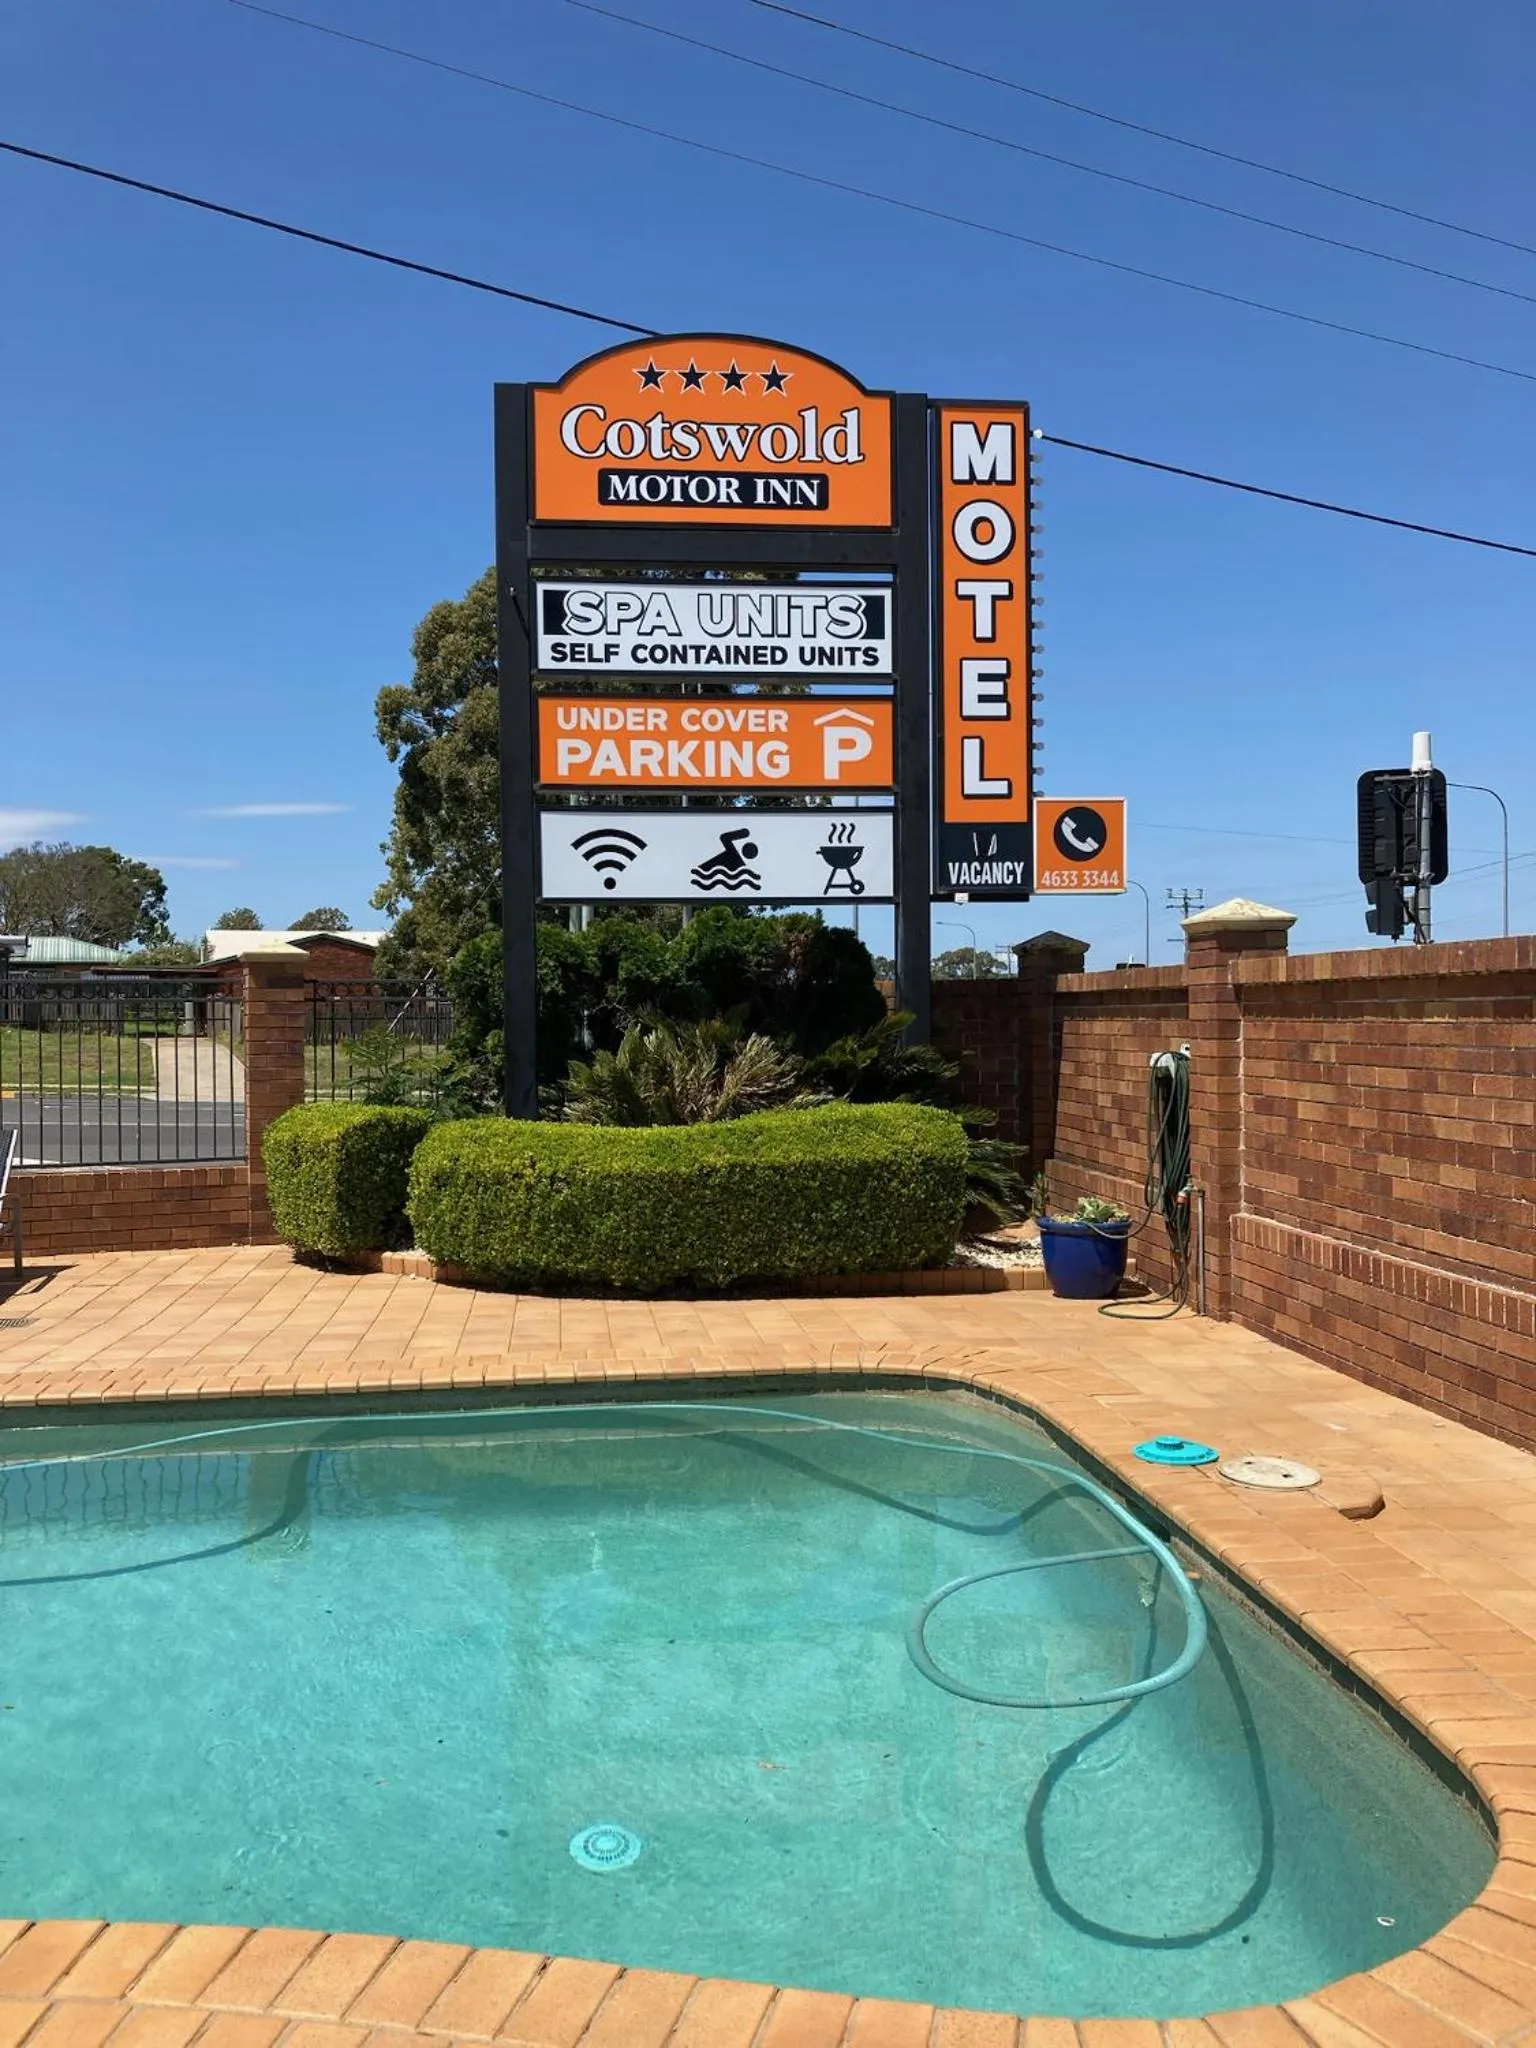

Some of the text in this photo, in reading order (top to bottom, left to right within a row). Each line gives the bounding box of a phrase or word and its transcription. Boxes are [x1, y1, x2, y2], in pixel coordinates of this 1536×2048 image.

[560, 404, 864, 464] Cotswold
[608, 474, 820, 506] MOTOR INN
[564, 591, 865, 639] SPA UNITS
[951, 421, 1016, 799] MOTEL
[550, 642, 879, 666] SELF CONTAINED UNITS
[557, 707, 788, 732] UNDER COVER
[557, 739, 790, 779] PARKING
[948, 861, 1024, 885] VACANCY
[1041, 870, 1120, 886] 4633 3344
